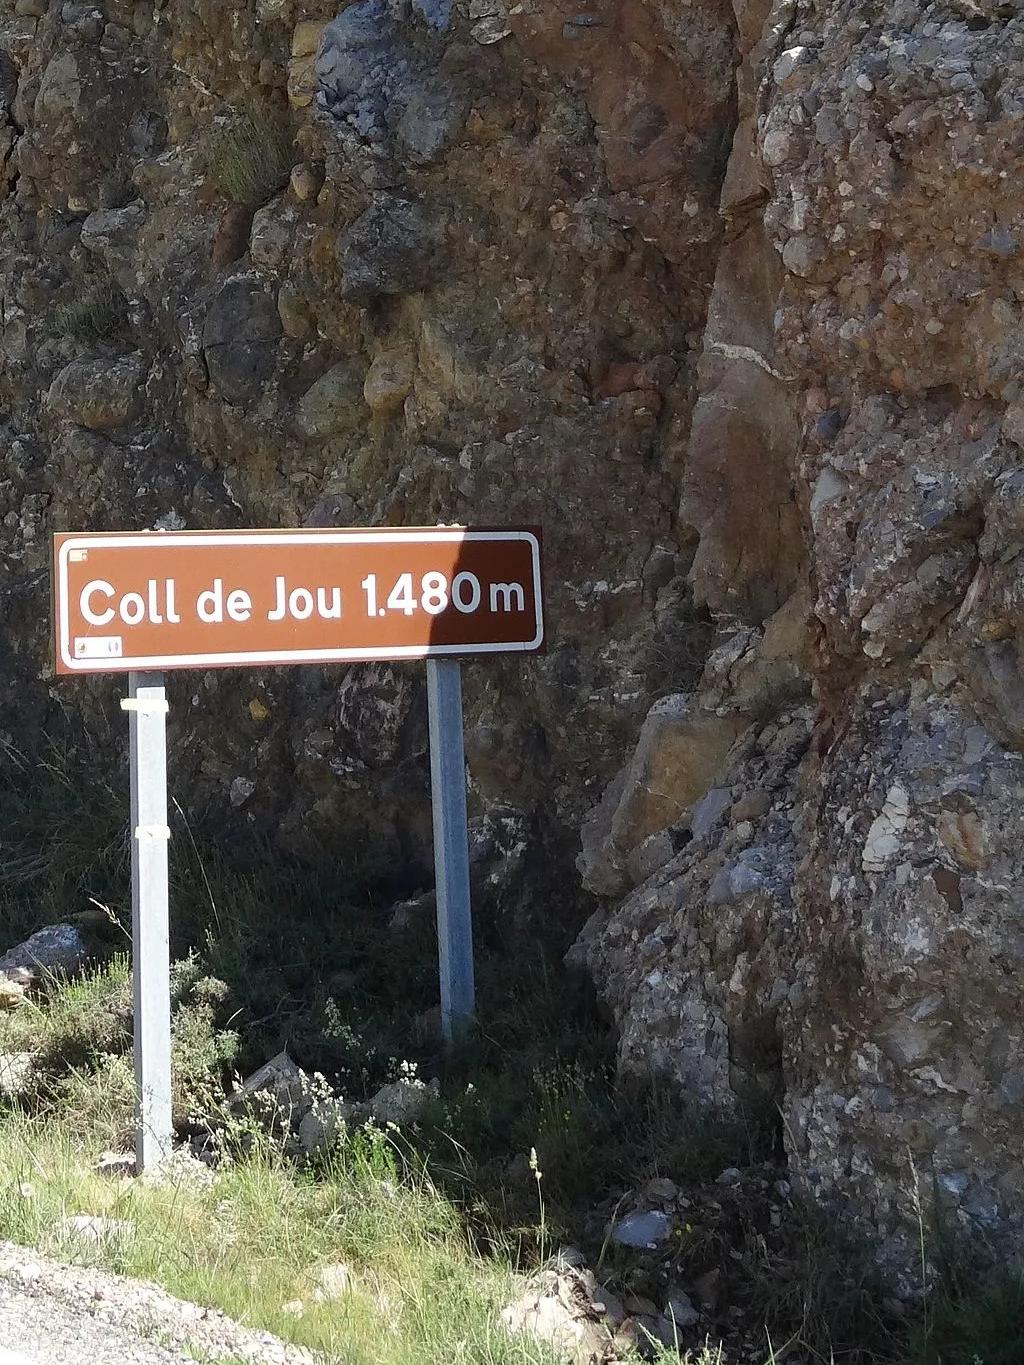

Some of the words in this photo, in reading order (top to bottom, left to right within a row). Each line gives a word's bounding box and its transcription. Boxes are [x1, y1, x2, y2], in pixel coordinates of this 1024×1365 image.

[79, 577, 181, 627] Coll
[196, 576, 252, 623] de
[267, 576, 342, 622] Jou
